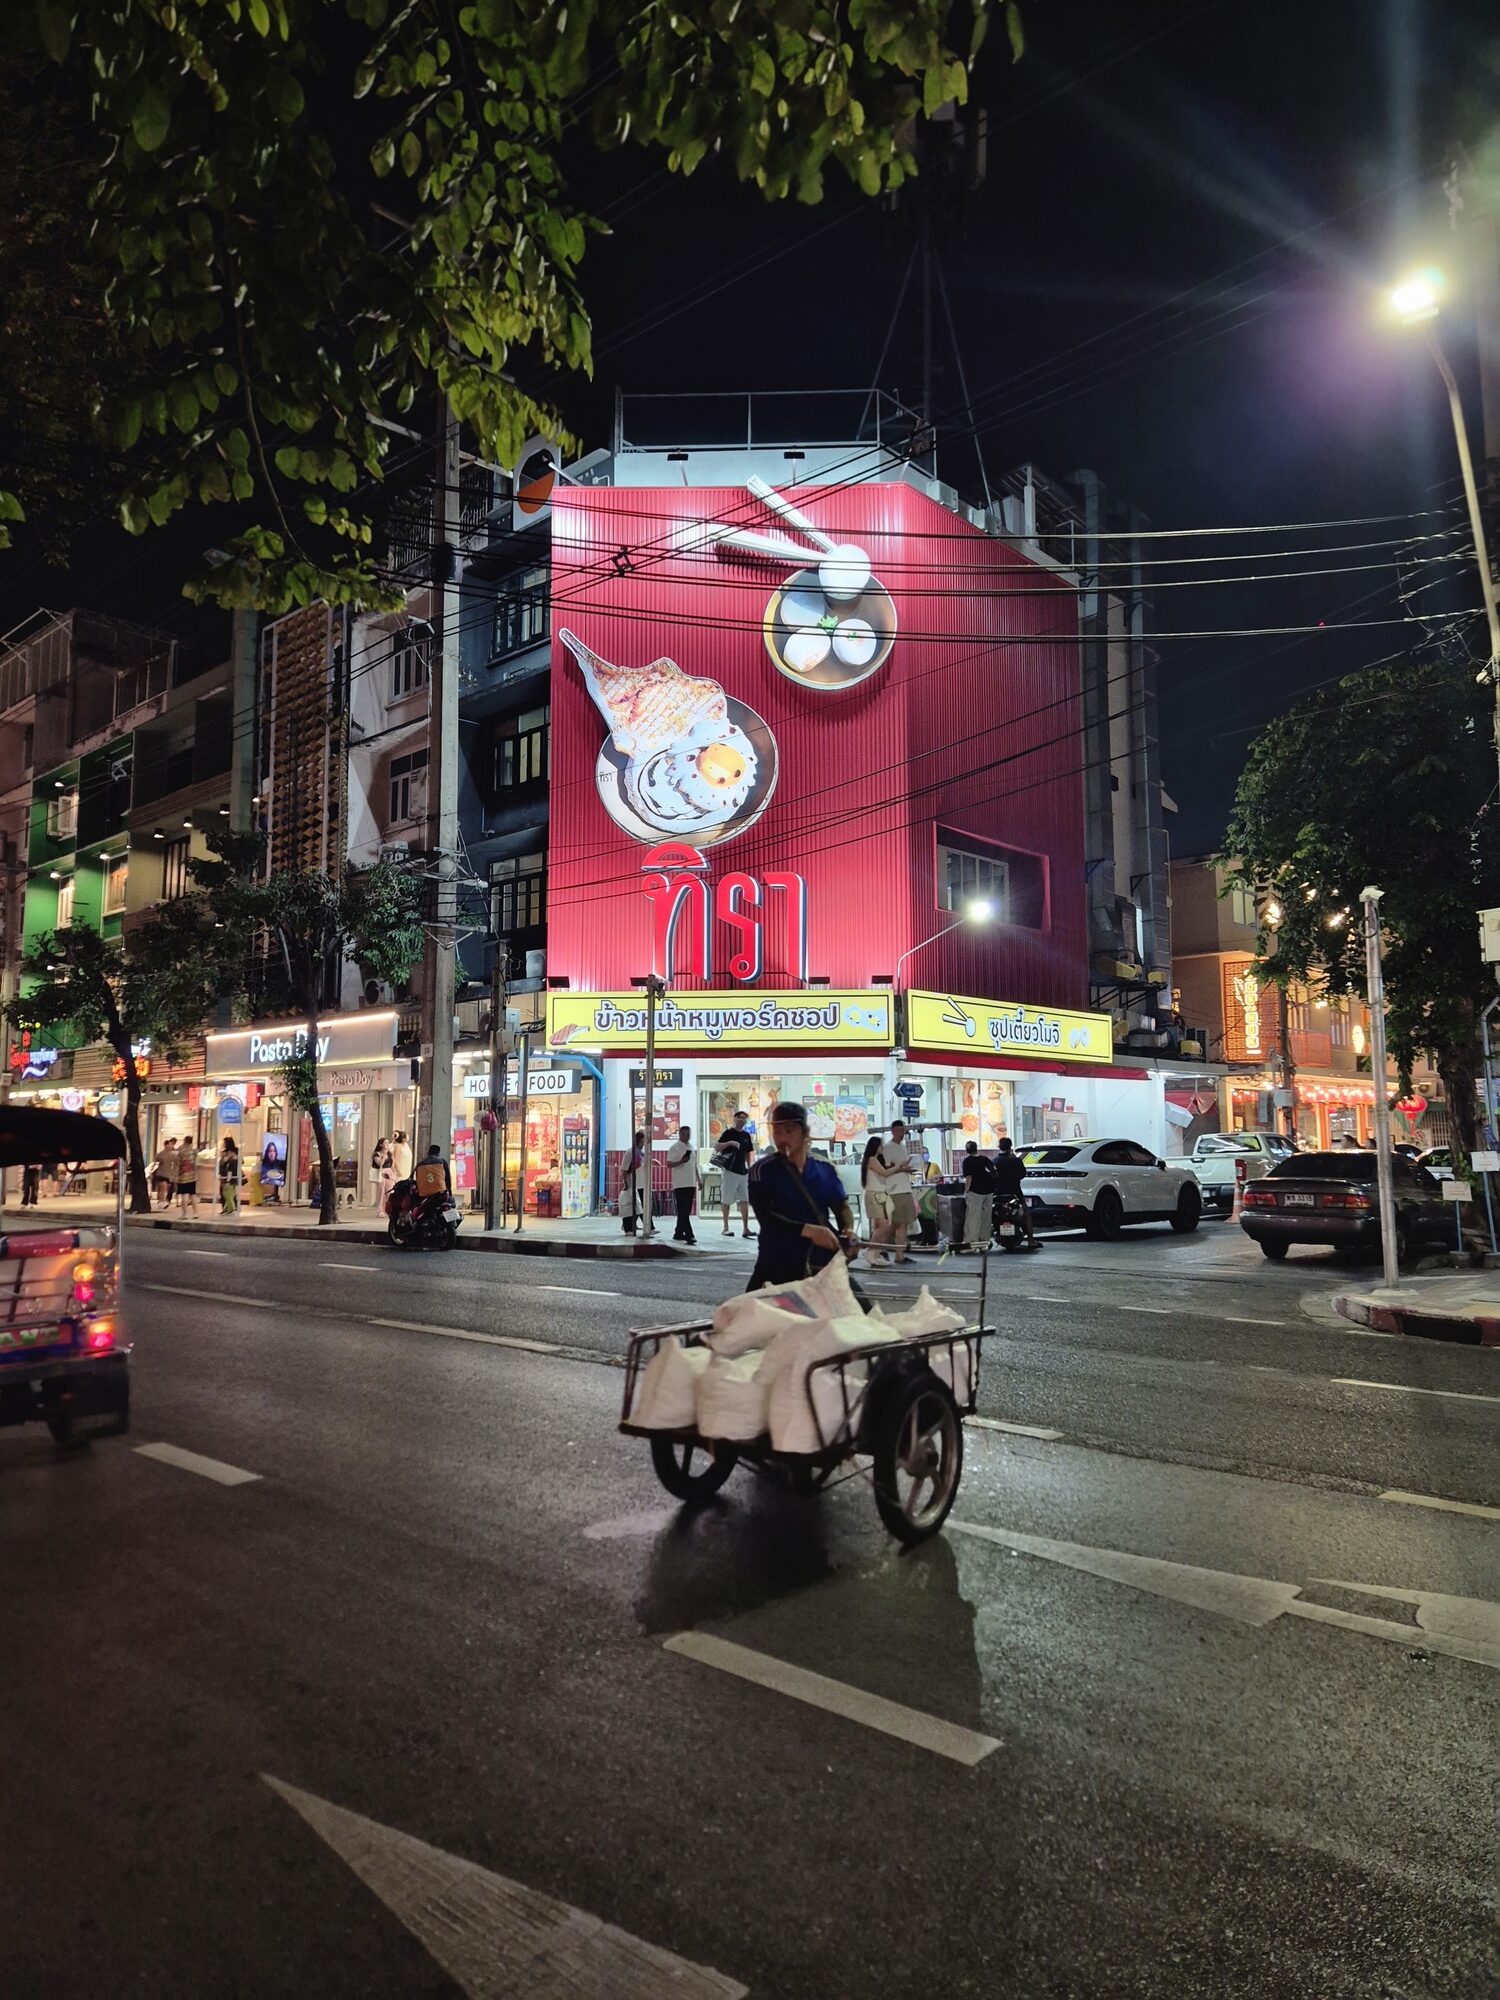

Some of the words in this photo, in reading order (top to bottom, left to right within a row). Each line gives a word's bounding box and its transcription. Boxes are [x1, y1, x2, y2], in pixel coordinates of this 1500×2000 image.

[640, 841, 809, 984] ทิรา
[250, 1034, 292, 1063] Pasta
[295, 1029, 330, 1063] Dy
[469, 1077, 511, 1094] HOE
[529, 1074, 567, 1091] FOOD
